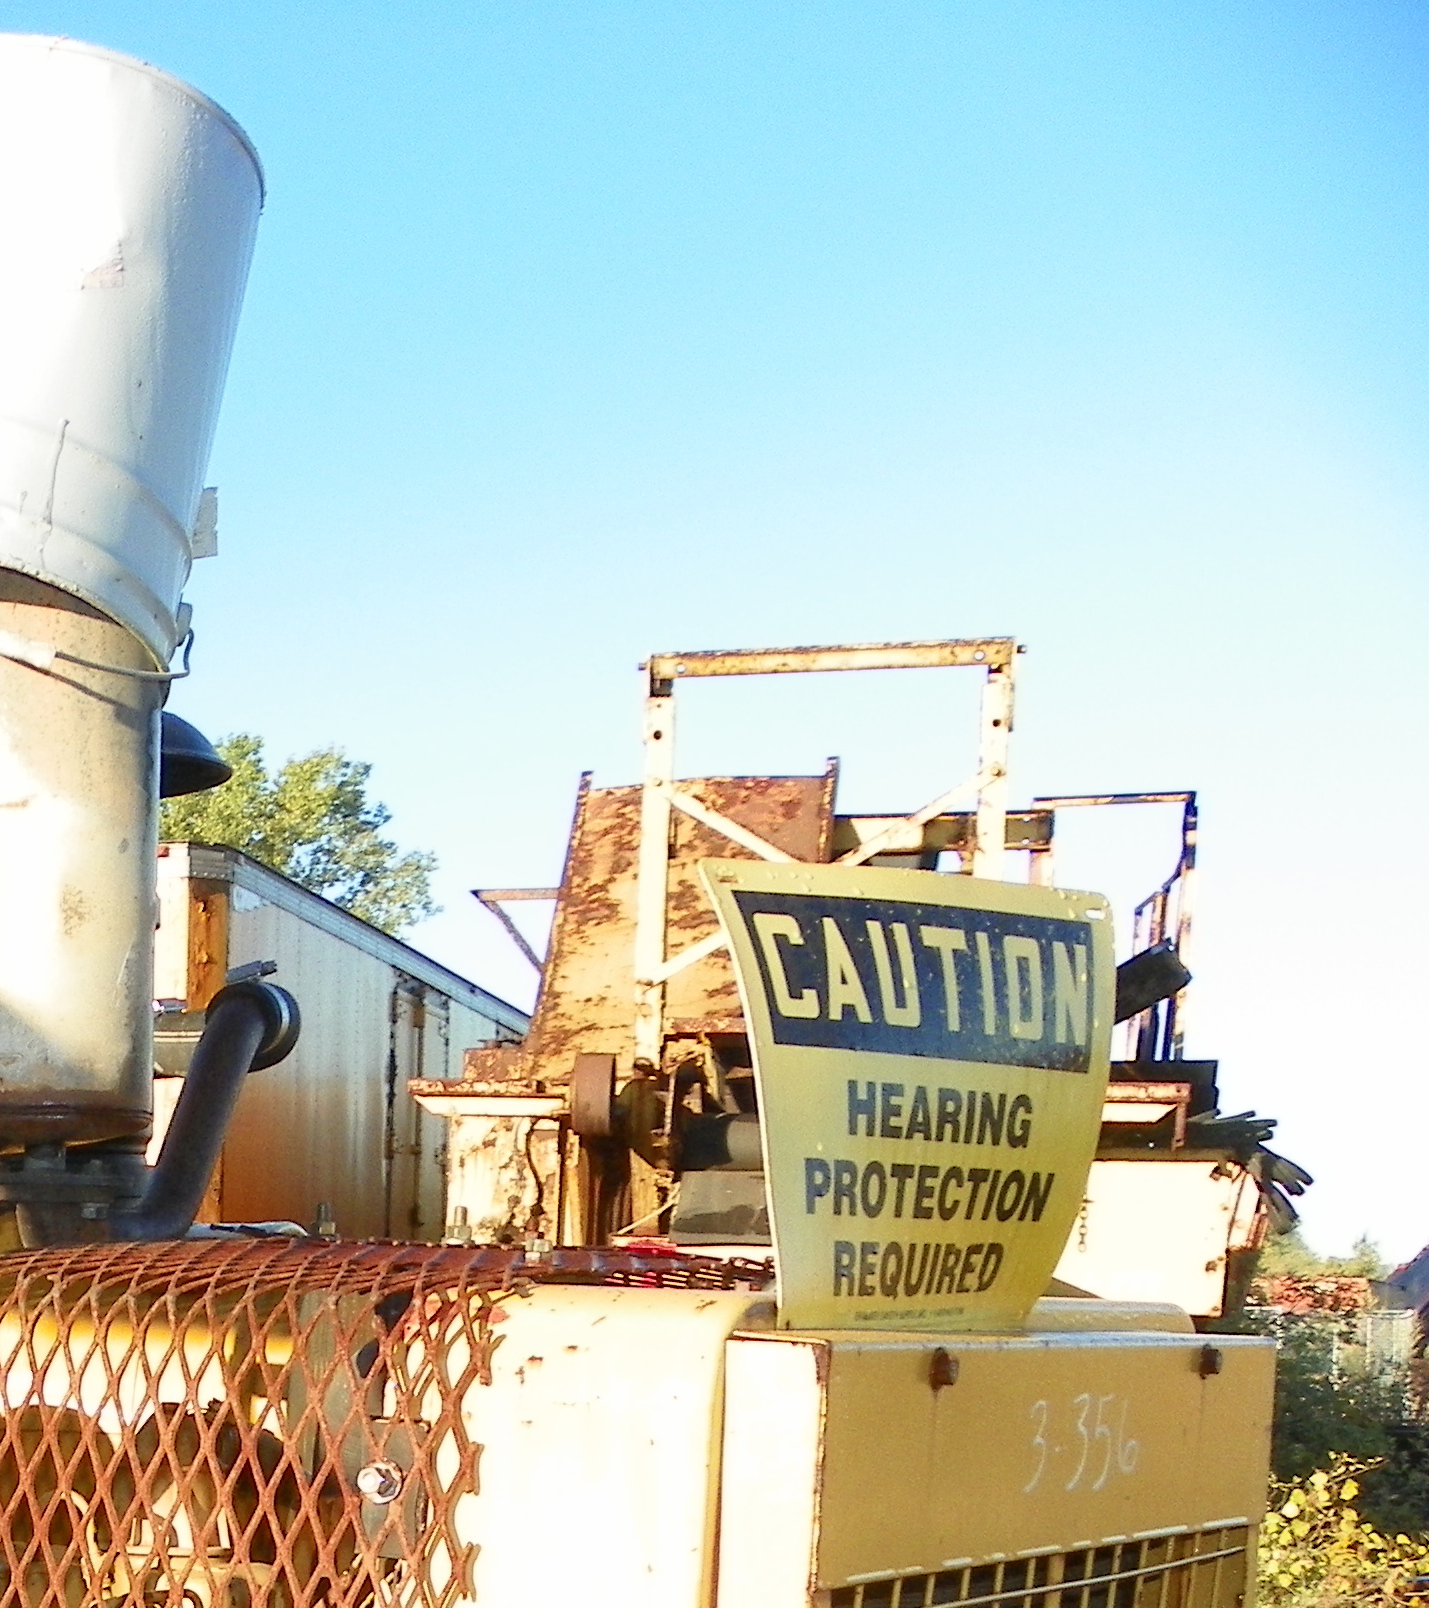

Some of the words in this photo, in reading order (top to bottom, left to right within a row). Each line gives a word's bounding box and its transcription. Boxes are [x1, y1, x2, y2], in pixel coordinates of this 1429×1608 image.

[752, 911, 1087, 1046] CAUTION
[847, 1079, 1034, 1149] HEARING
[804, 1158, 1055, 1223] PROTECTION
[833, 1240, 1004, 1299] REQUIRED
